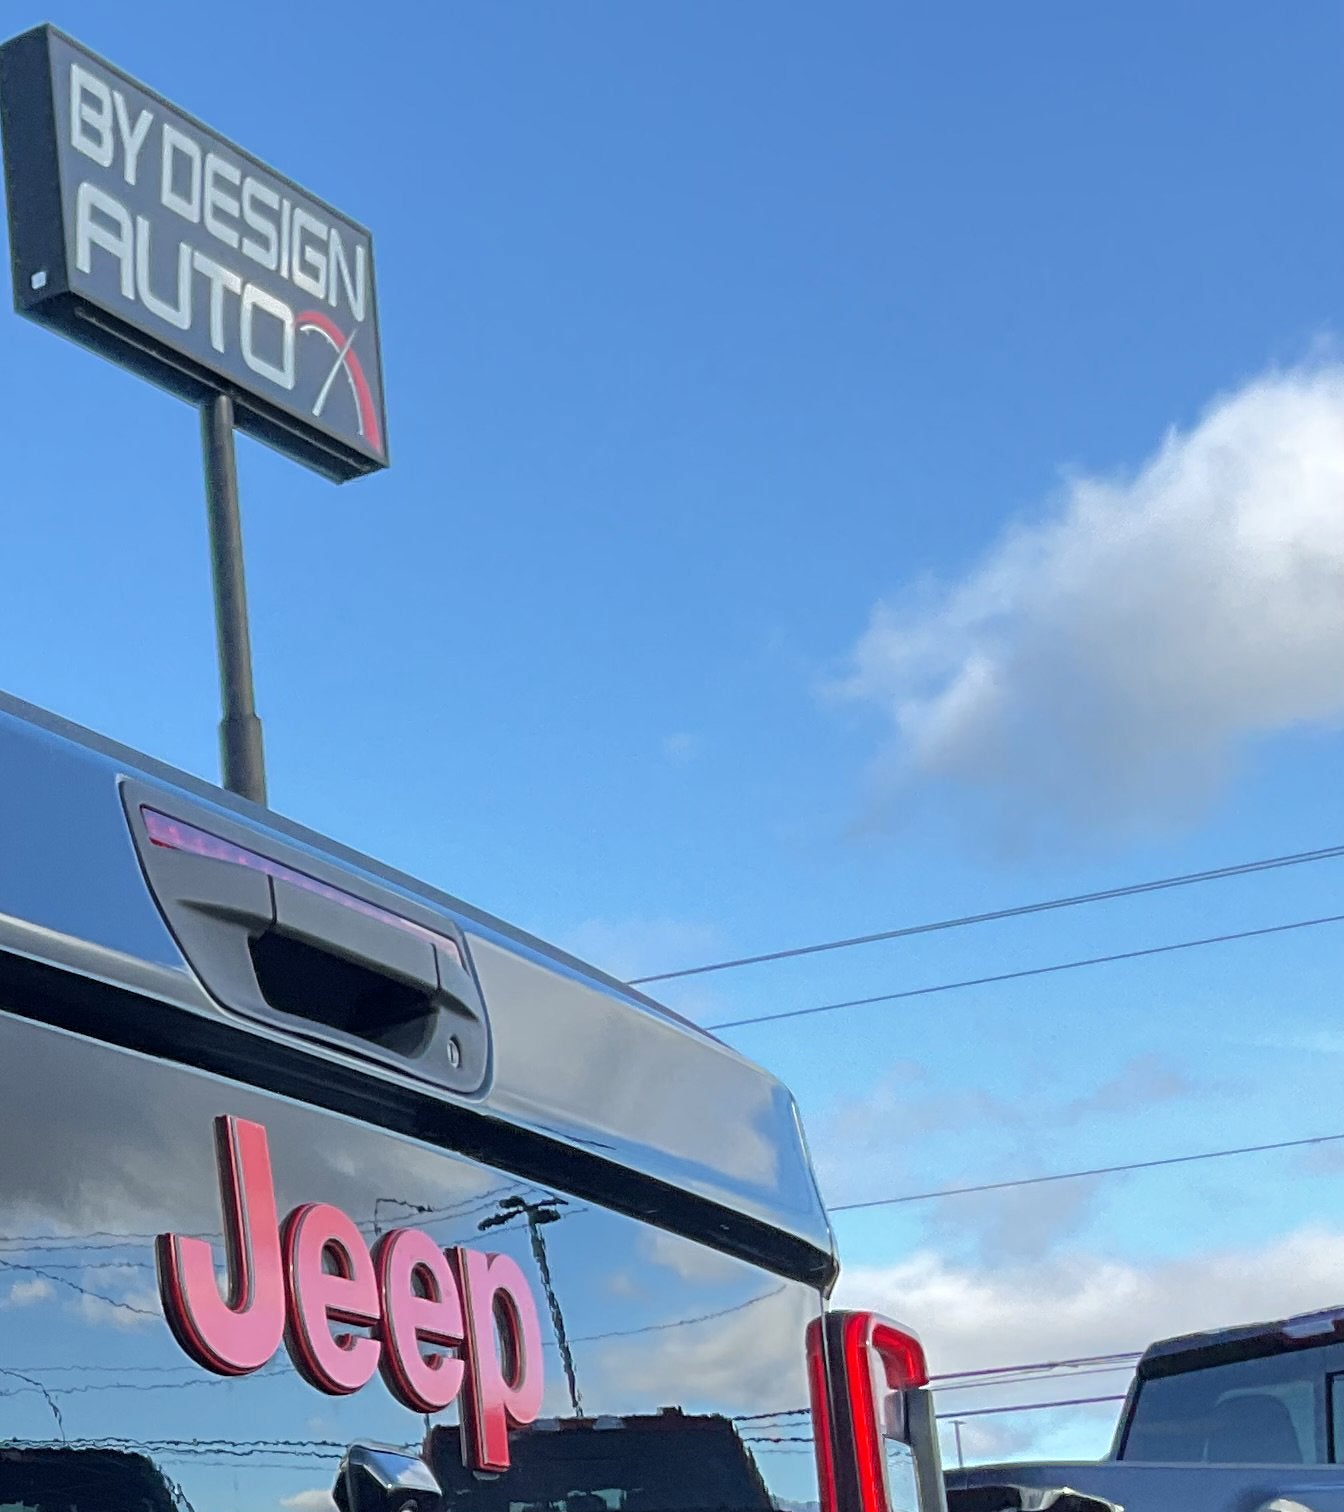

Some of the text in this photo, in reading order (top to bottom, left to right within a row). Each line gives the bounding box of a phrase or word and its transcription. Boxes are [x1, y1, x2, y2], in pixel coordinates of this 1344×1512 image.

[70, 63, 365, 322] BY DESIGN
[75, 182, 296, 391] AUTO
[154, 1113, 544, 1474] Jeep
